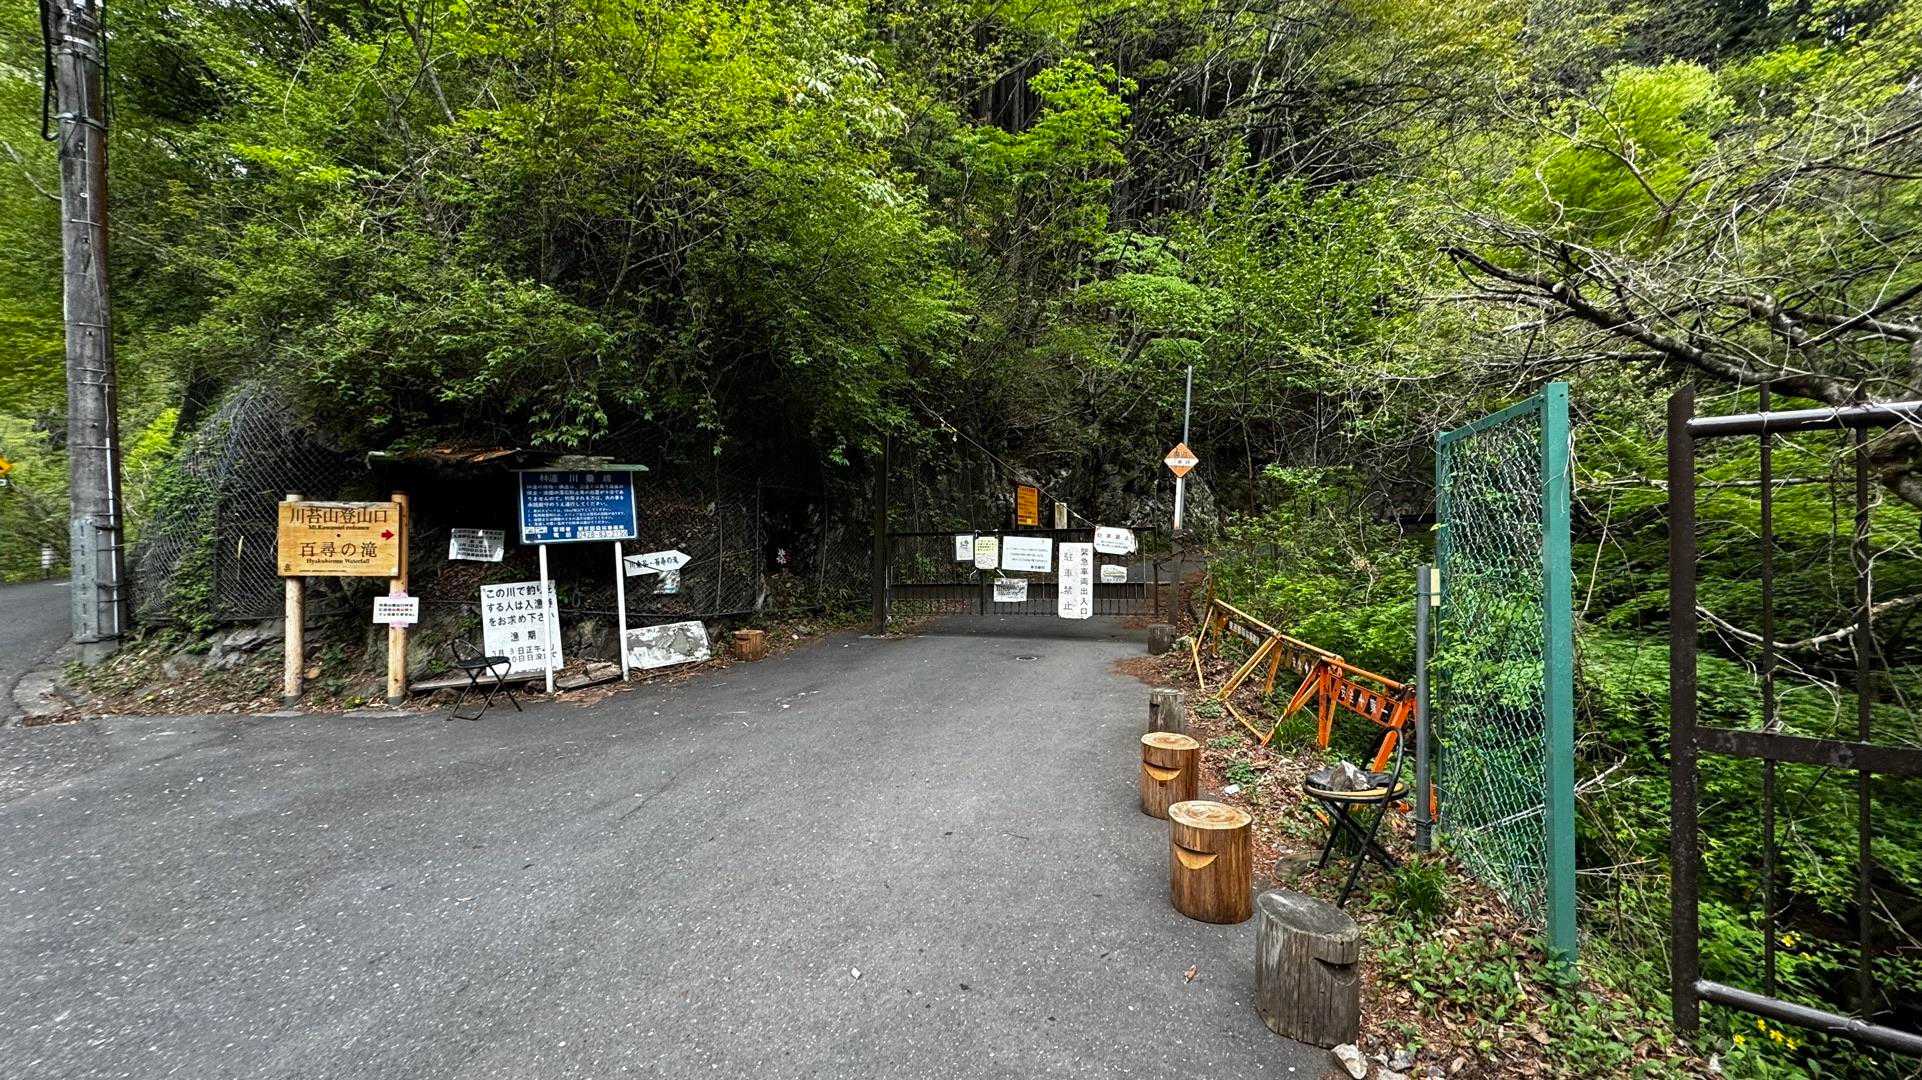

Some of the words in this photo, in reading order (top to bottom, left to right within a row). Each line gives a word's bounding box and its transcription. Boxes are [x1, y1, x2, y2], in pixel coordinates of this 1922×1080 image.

[290, 507, 387, 524] 川苔山登山口
[300, 541, 377, 558] 百尋の滝
[1080, 547, 1089, 615] 緊急車両出入口
